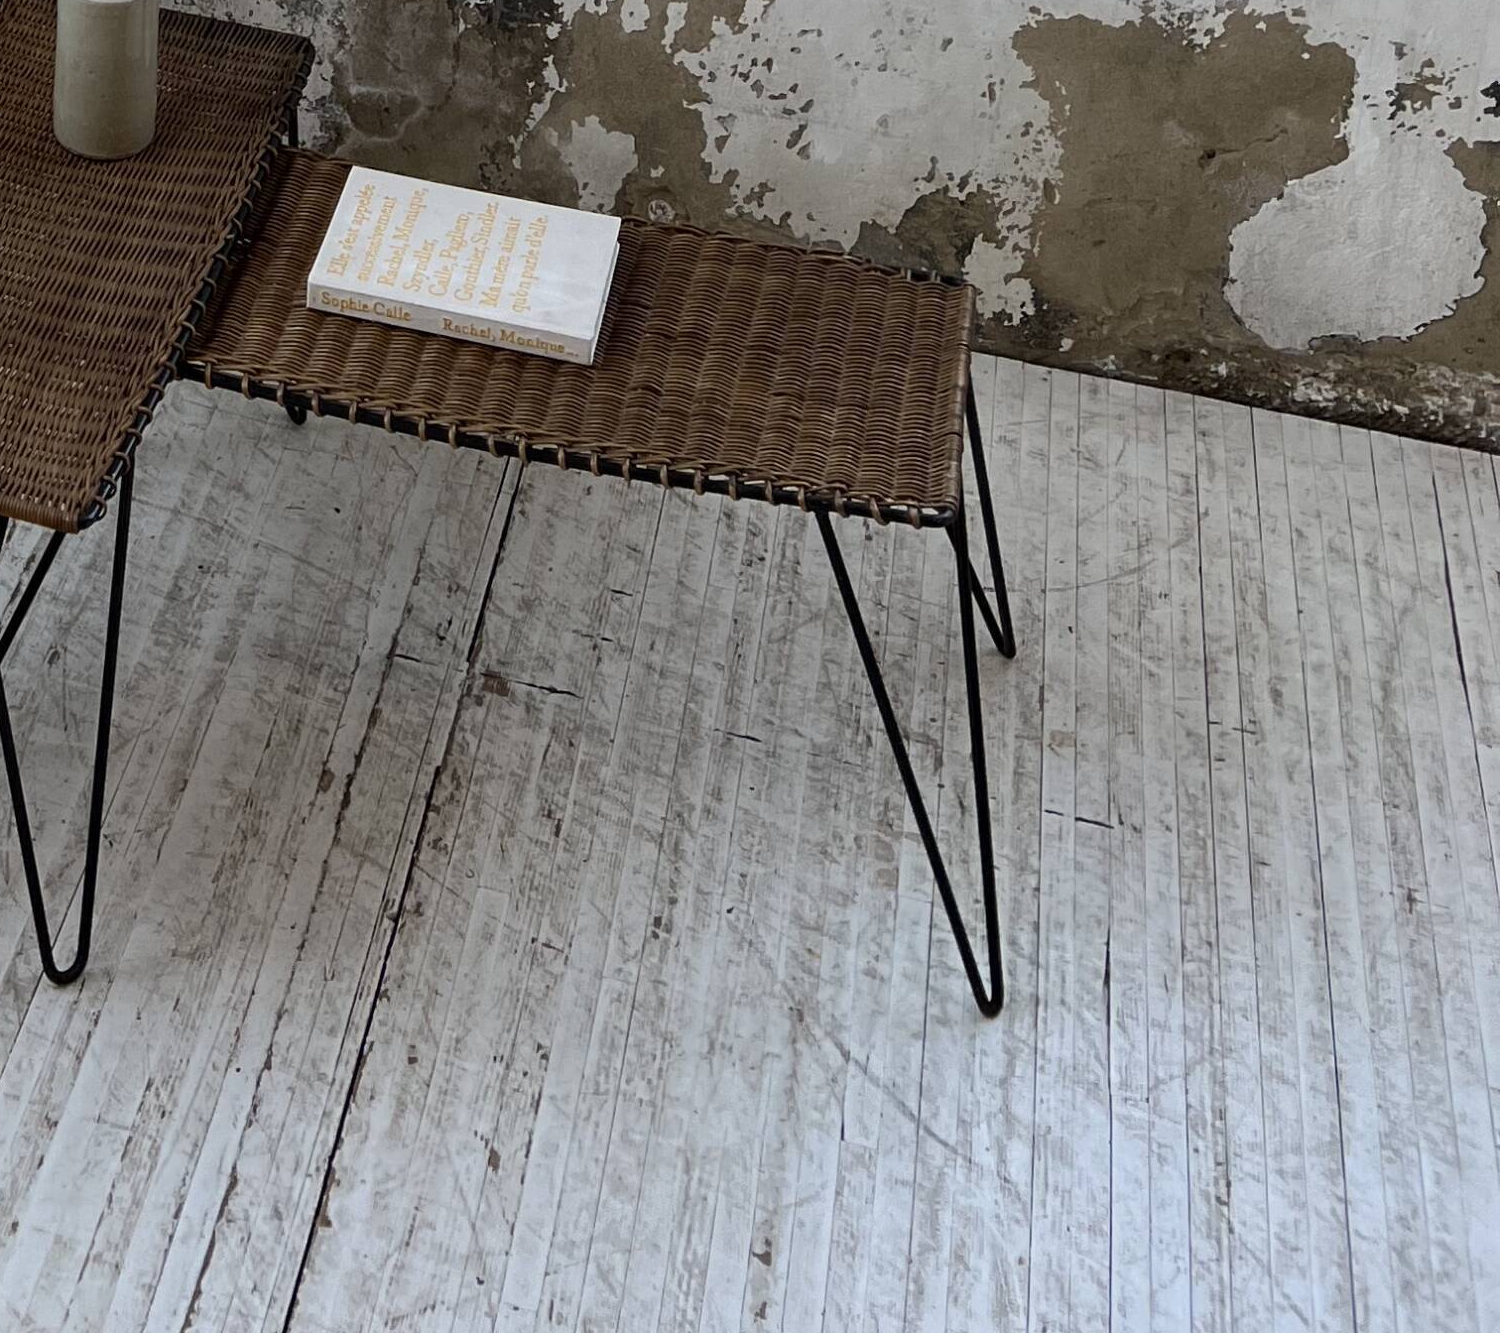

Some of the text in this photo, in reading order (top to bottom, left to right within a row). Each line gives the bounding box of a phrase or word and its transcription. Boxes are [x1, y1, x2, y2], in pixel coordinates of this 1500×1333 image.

[357, 196, 397, 281] successivement
[377, 187, 430, 287] Rachel, Monique,
[327, 252, 351, 277] Elle
[402, 238, 440, 292] Szyndler,
[428, 262, 459, 296] Calle,
[453, 245, 490, 302] Gonthier,
[479, 286, 501, 308] Ma
[499, 216, 522, 254] aimait
[520, 248, 539, 281] parle
[321, 291, 412, 322] Sophie Calle
[442, 317, 496, 343] Rachel,
